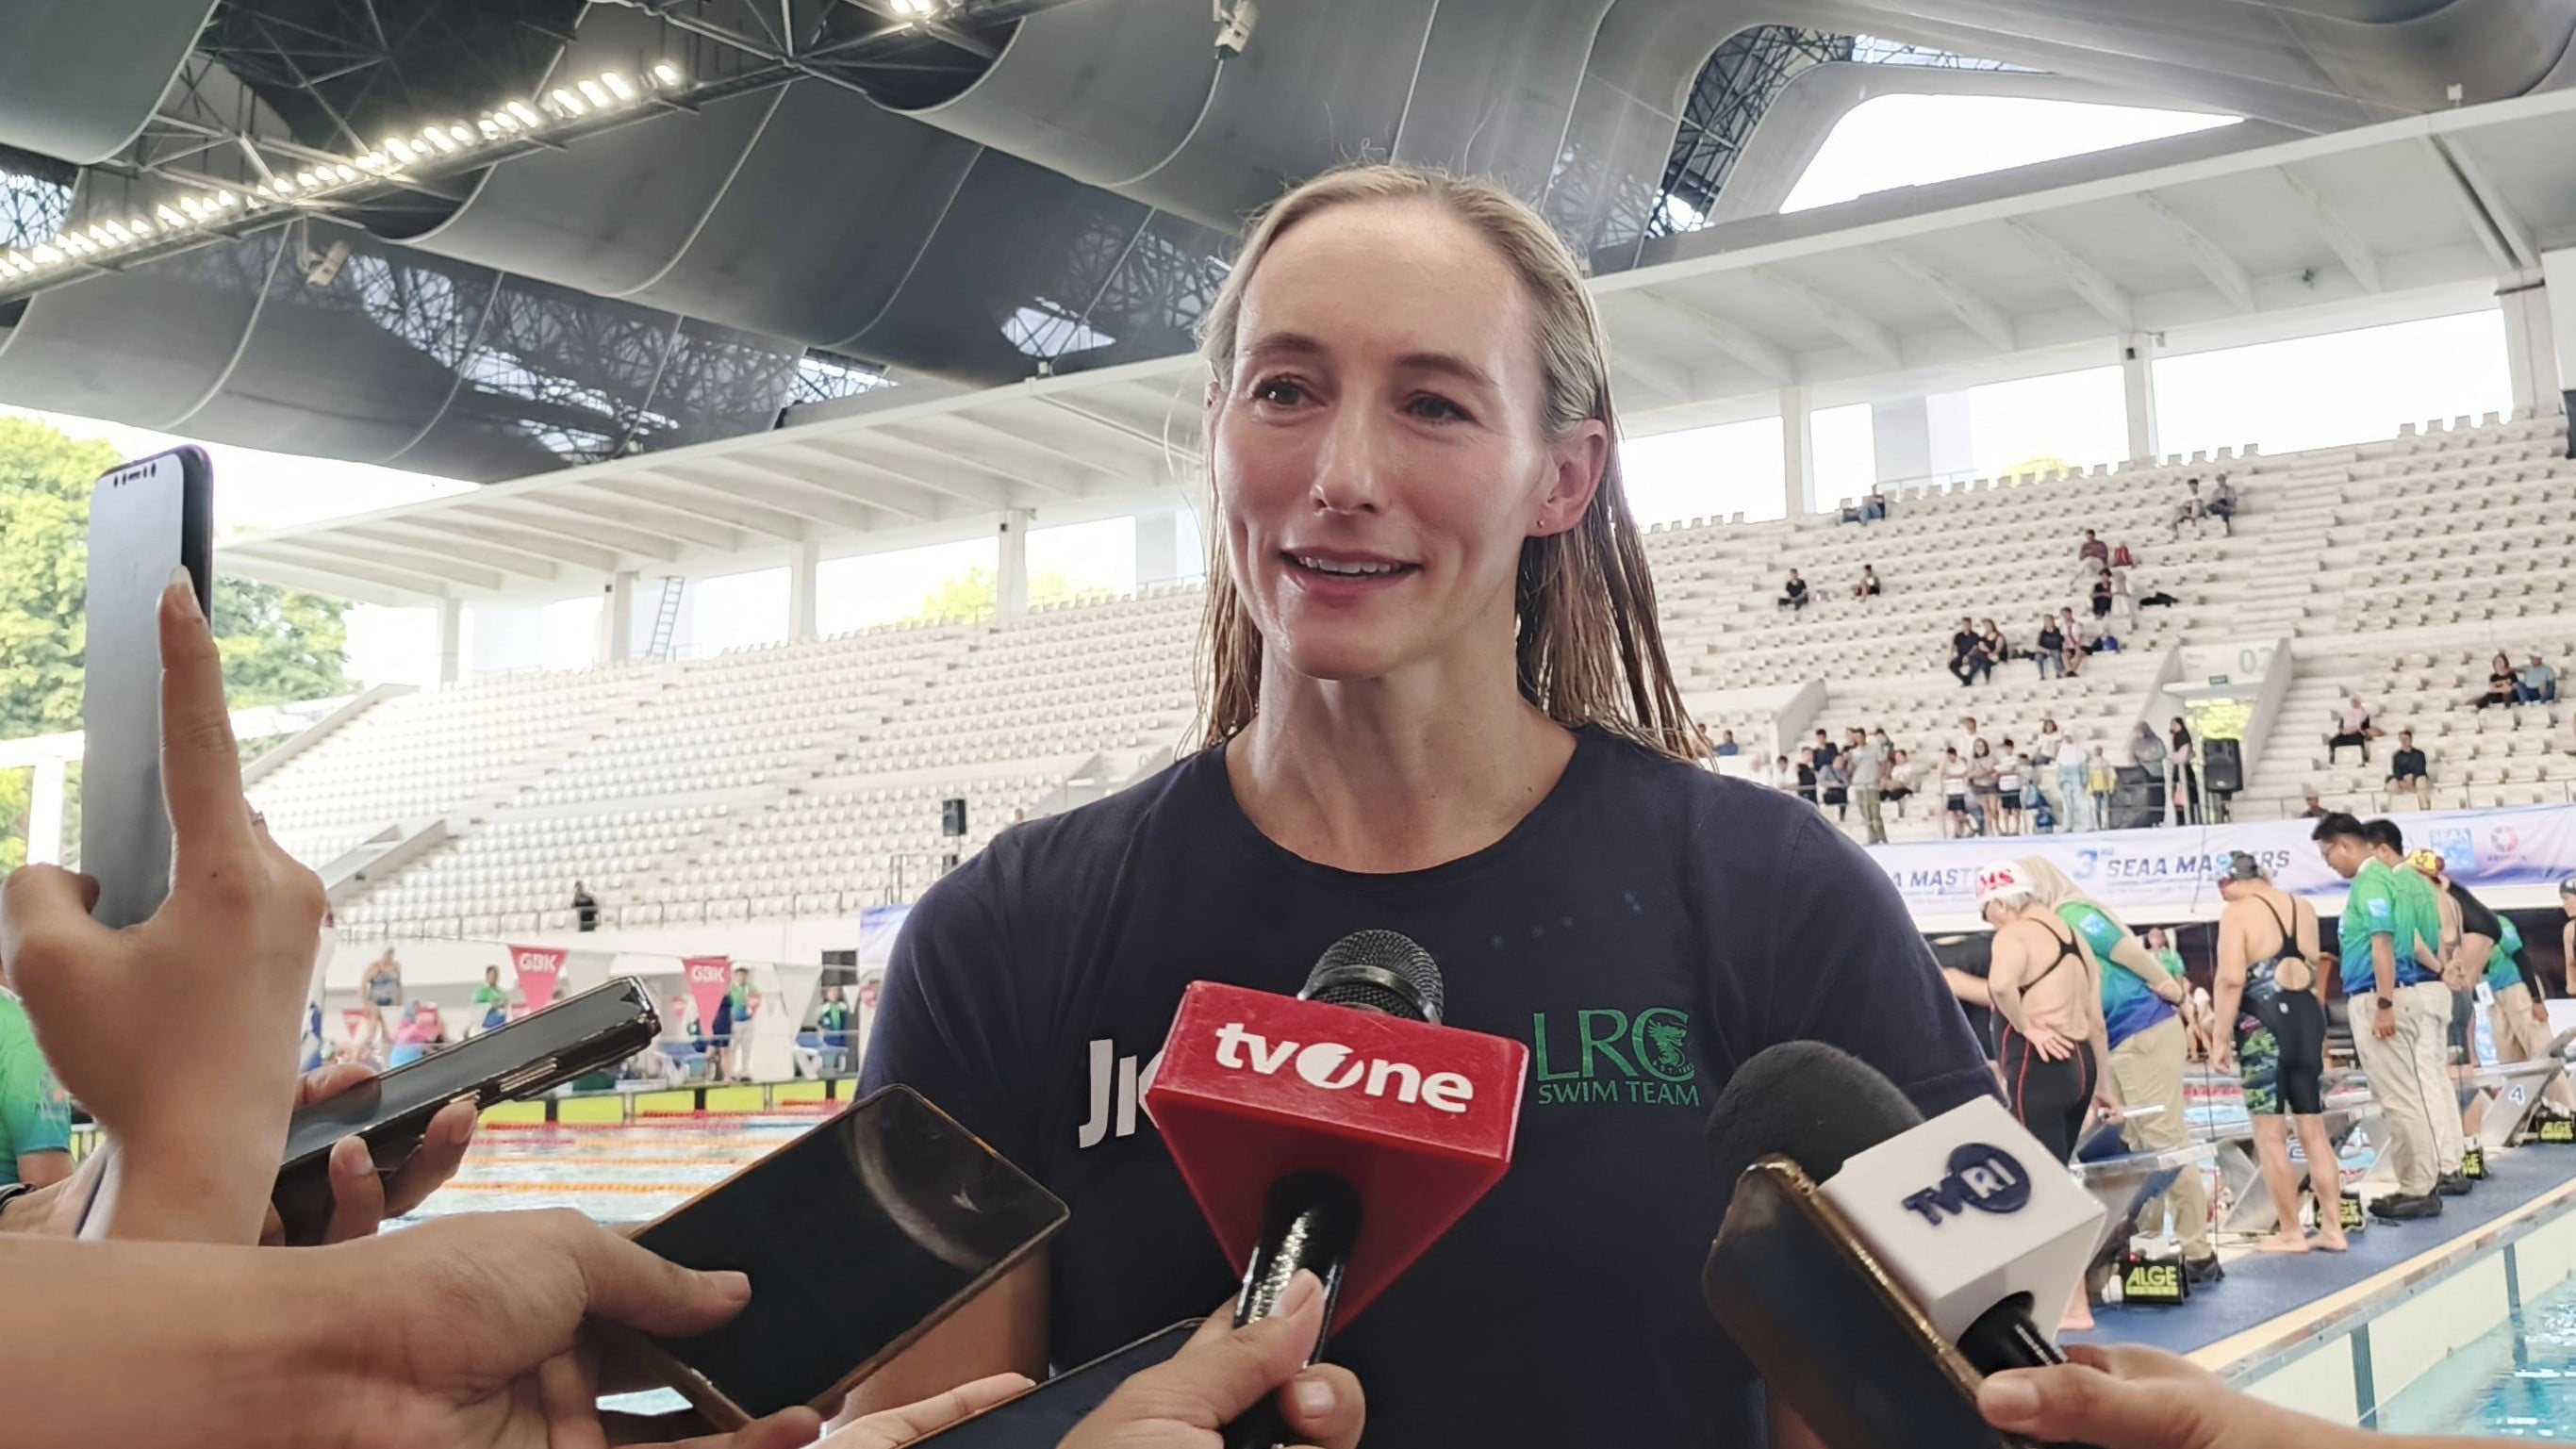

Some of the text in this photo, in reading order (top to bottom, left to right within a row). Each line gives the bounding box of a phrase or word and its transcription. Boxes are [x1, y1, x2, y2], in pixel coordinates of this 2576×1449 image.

[2107, 857, 2168, 878] SEAA
[2175, 850, 2290, 874] MARS
[520, 951, 557, 973] GBK
[690, 965, 725, 982] GBK
[1533, 1007, 1695, 1082] LRC
[1538, 1080, 1701, 1107] SWIM TEAM
[1901, 1143, 2032, 1226] TVRI
[2125, 1265, 2178, 1286] ALGE
